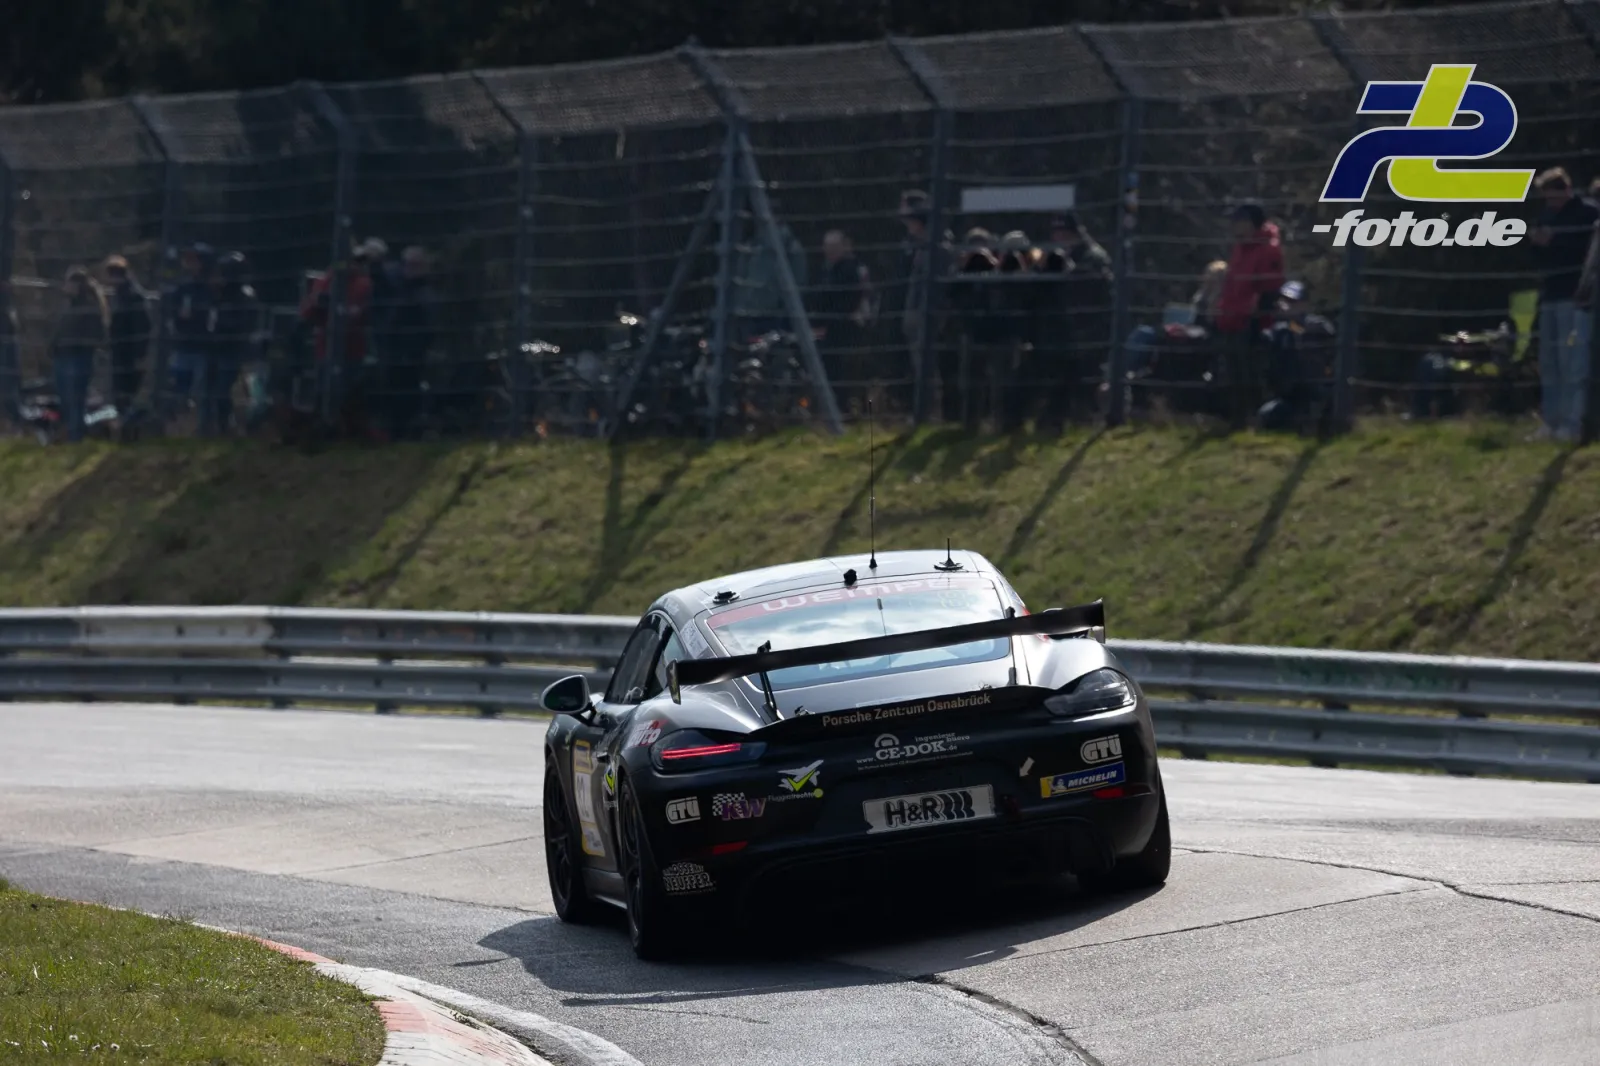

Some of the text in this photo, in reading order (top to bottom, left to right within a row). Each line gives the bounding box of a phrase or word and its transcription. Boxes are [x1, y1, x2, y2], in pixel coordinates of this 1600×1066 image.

[822, 692, 992, 727] Porsche Zentrum Osnabrück
[1068, 769, 1118, 788] MICHELIN
[721, 797, 767, 821] KW
[884, 795, 942, 828] H&R
